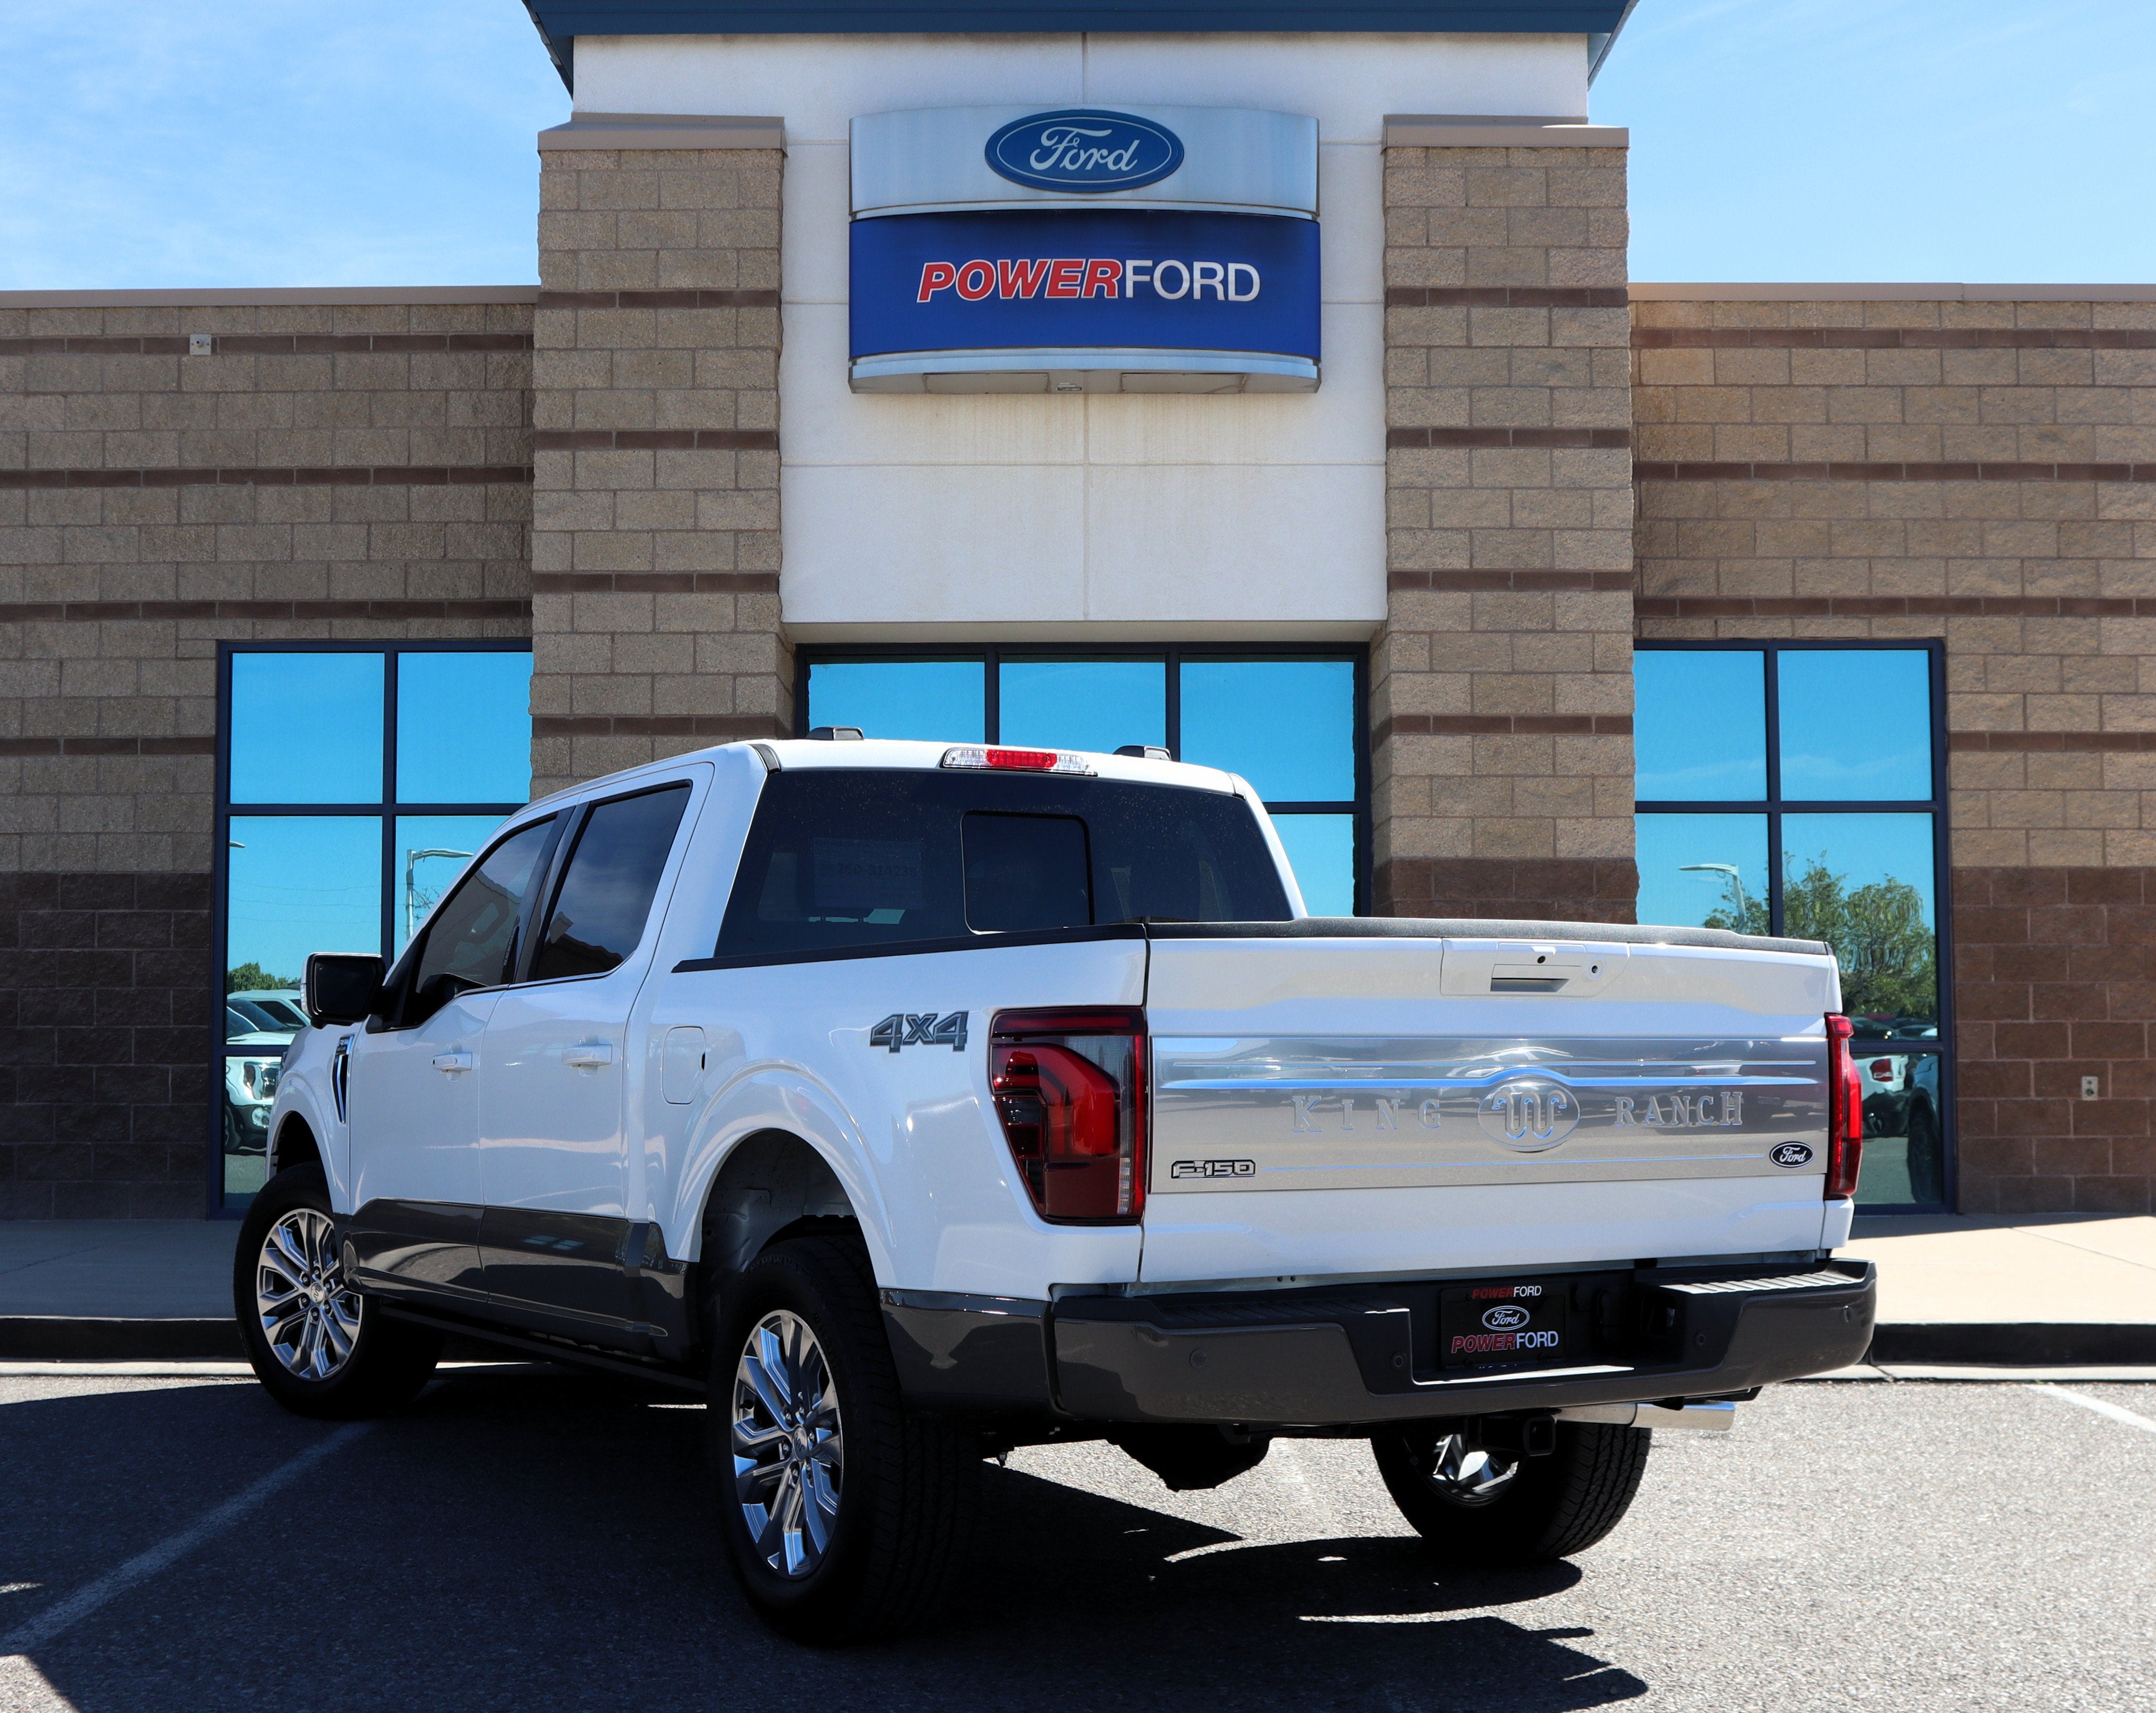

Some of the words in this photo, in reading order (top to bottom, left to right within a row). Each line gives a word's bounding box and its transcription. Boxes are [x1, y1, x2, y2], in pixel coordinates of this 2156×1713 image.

[1030, 126, 1140, 171] Ford
[917, 258, 1260, 303] POWERFORD
[1292, 1095, 1441, 1133] KING
[1614, 1091, 1743, 1126] RANCH
[1779, 1146, 1807, 1162] Ford
[1171, 1160, 1256, 1179] F-150
[1492, 1310, 1520, 1325] Ford
